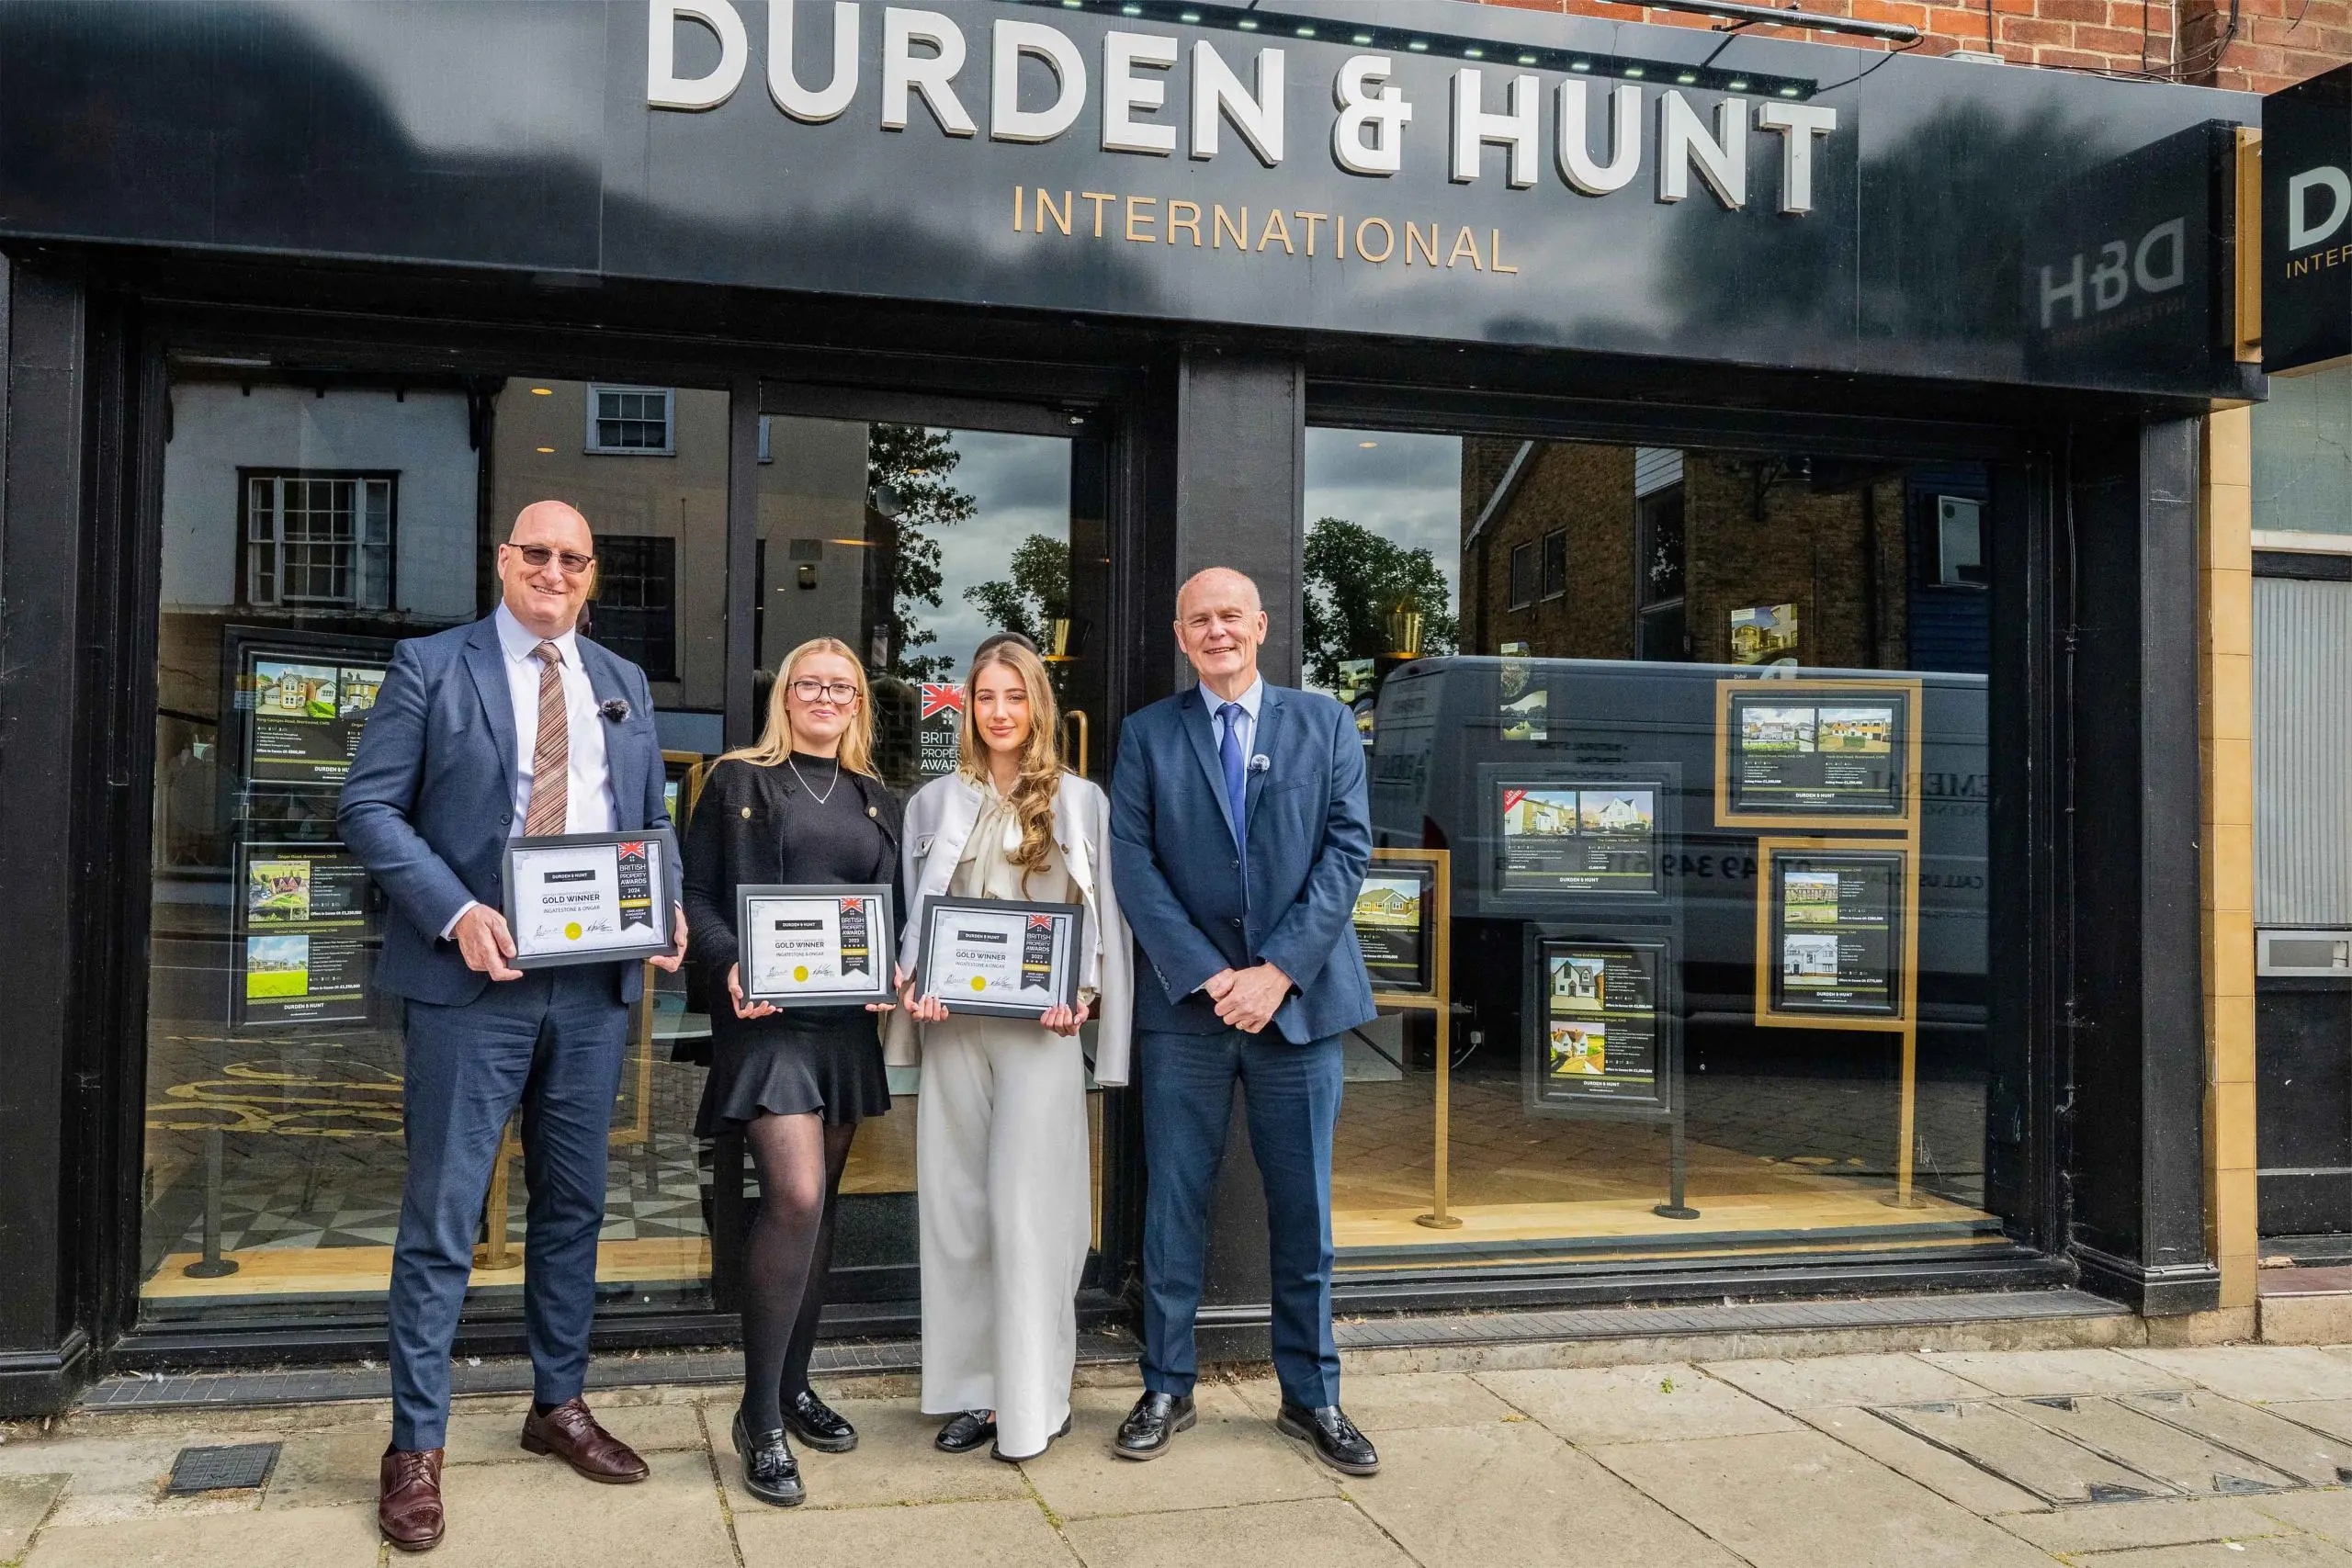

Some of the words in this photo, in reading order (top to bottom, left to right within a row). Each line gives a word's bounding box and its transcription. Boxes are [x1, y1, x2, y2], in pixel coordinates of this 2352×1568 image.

[647, 0, 1284, 165] DURDEN
[1332, 54, 1413, 177] &
[1449, 67, 1837, 215] HUNT
[1013, 185, 1520, 275] INTERNATIONAL
[921, 731, 961, 744] BRITIS
[922, 748, 962, 759] PROPER
[920, 759, 957, 771] AWAR
[619, 863, 647, 872] BRITISH
[620, 877, 648, 886] AWARDS
[542, 896, 565, 904] GOLD
[566, 894, 600, 902] WINNER
[956, 951, 976, 959] GOLD
[977, 953, 1006, 961] WINNER
